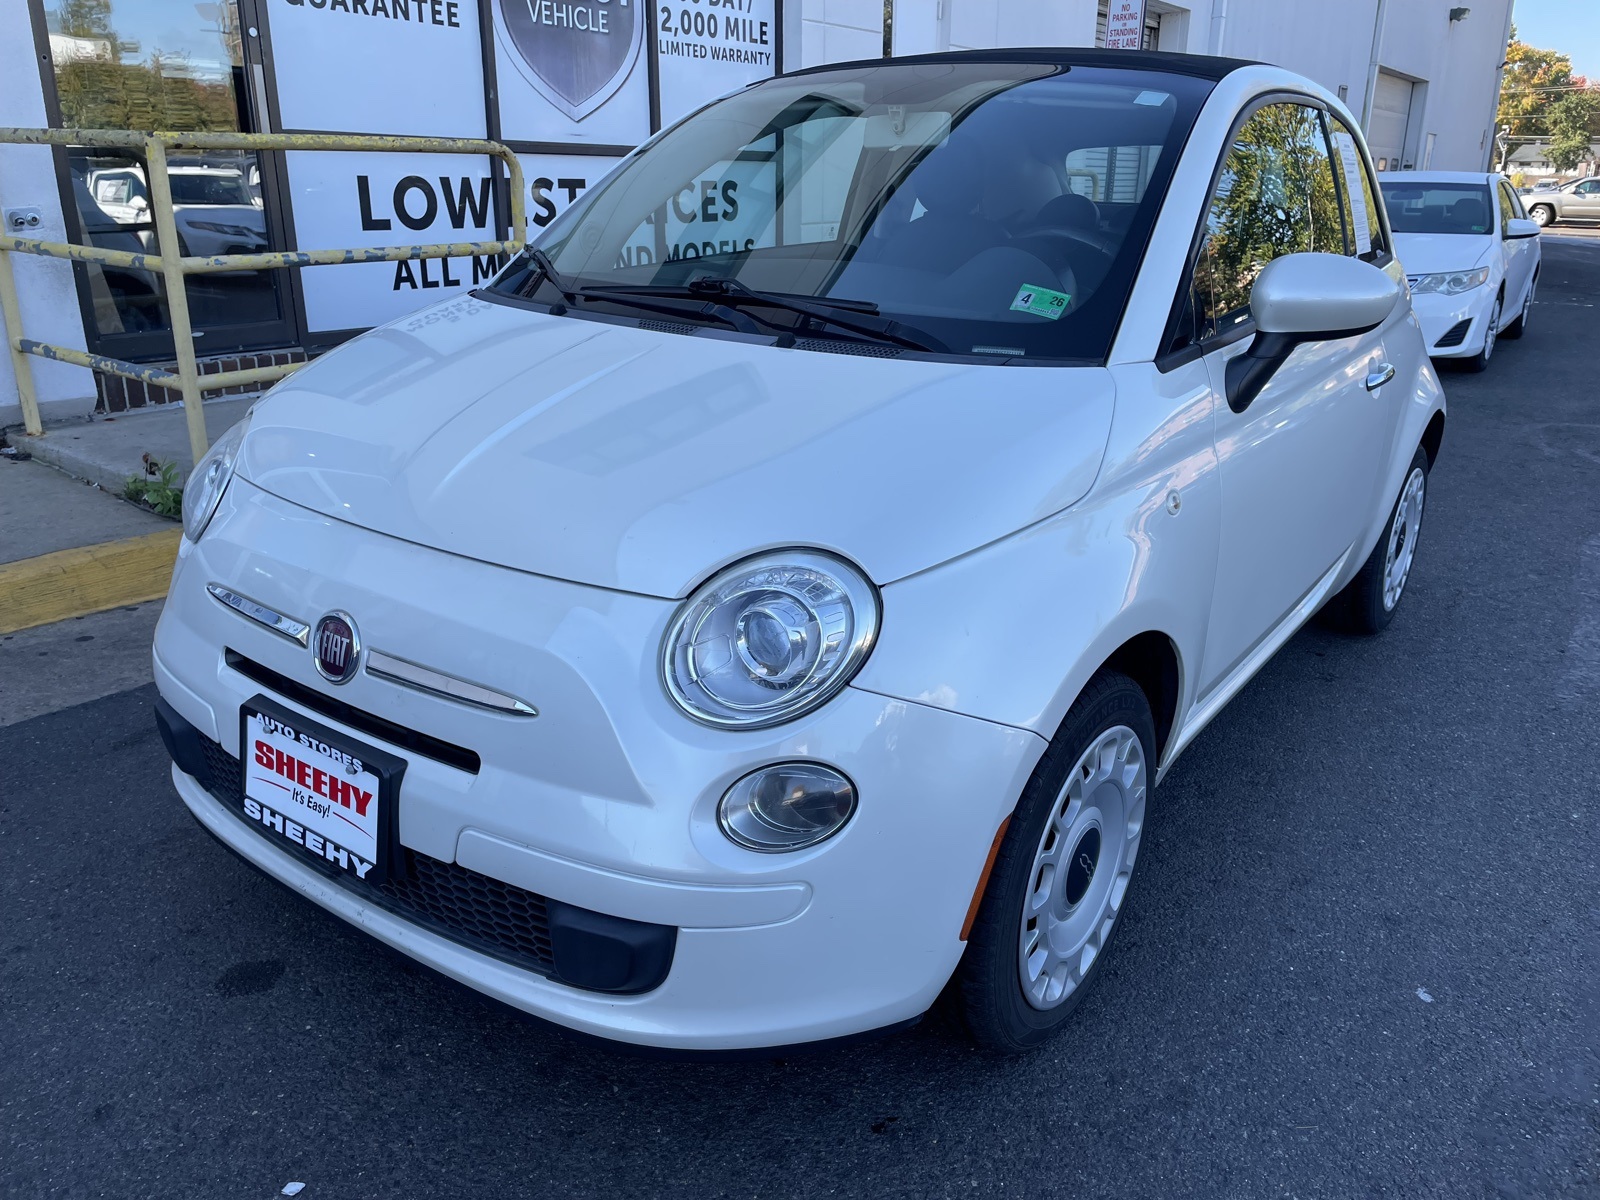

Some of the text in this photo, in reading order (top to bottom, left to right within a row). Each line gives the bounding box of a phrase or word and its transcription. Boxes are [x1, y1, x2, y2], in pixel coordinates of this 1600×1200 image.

[284, 0, 460, 28] ARANTEE
[527, 0, 609, 33] VEHICLE
[1112, 12, 1138, 22] PARKING
[1121, 4, 1131, 12] NO
[660, 6, 718, 38] 2,000
[725, 16, 769, 45] MILE
[1109, 28, 1138, 37] STANDING
[659, 39, 771, 66] LIMITED WARRANTY
[1108, 38, 1137, 48] FIRE LANE
[645, 180, 739, 224] ICES
[393, 257, 460, 291] ALL
[1021, 293, 1065, 307] 4 26
[321, 630, 350, 667] FIAT
[255, 712, 364, 773] AUTO STORES
[255, 739, 373, 817] SHEEHY
[291, 787, 331, 819] It's Easy!
[243, 798, 373, 879] SHEEHY
